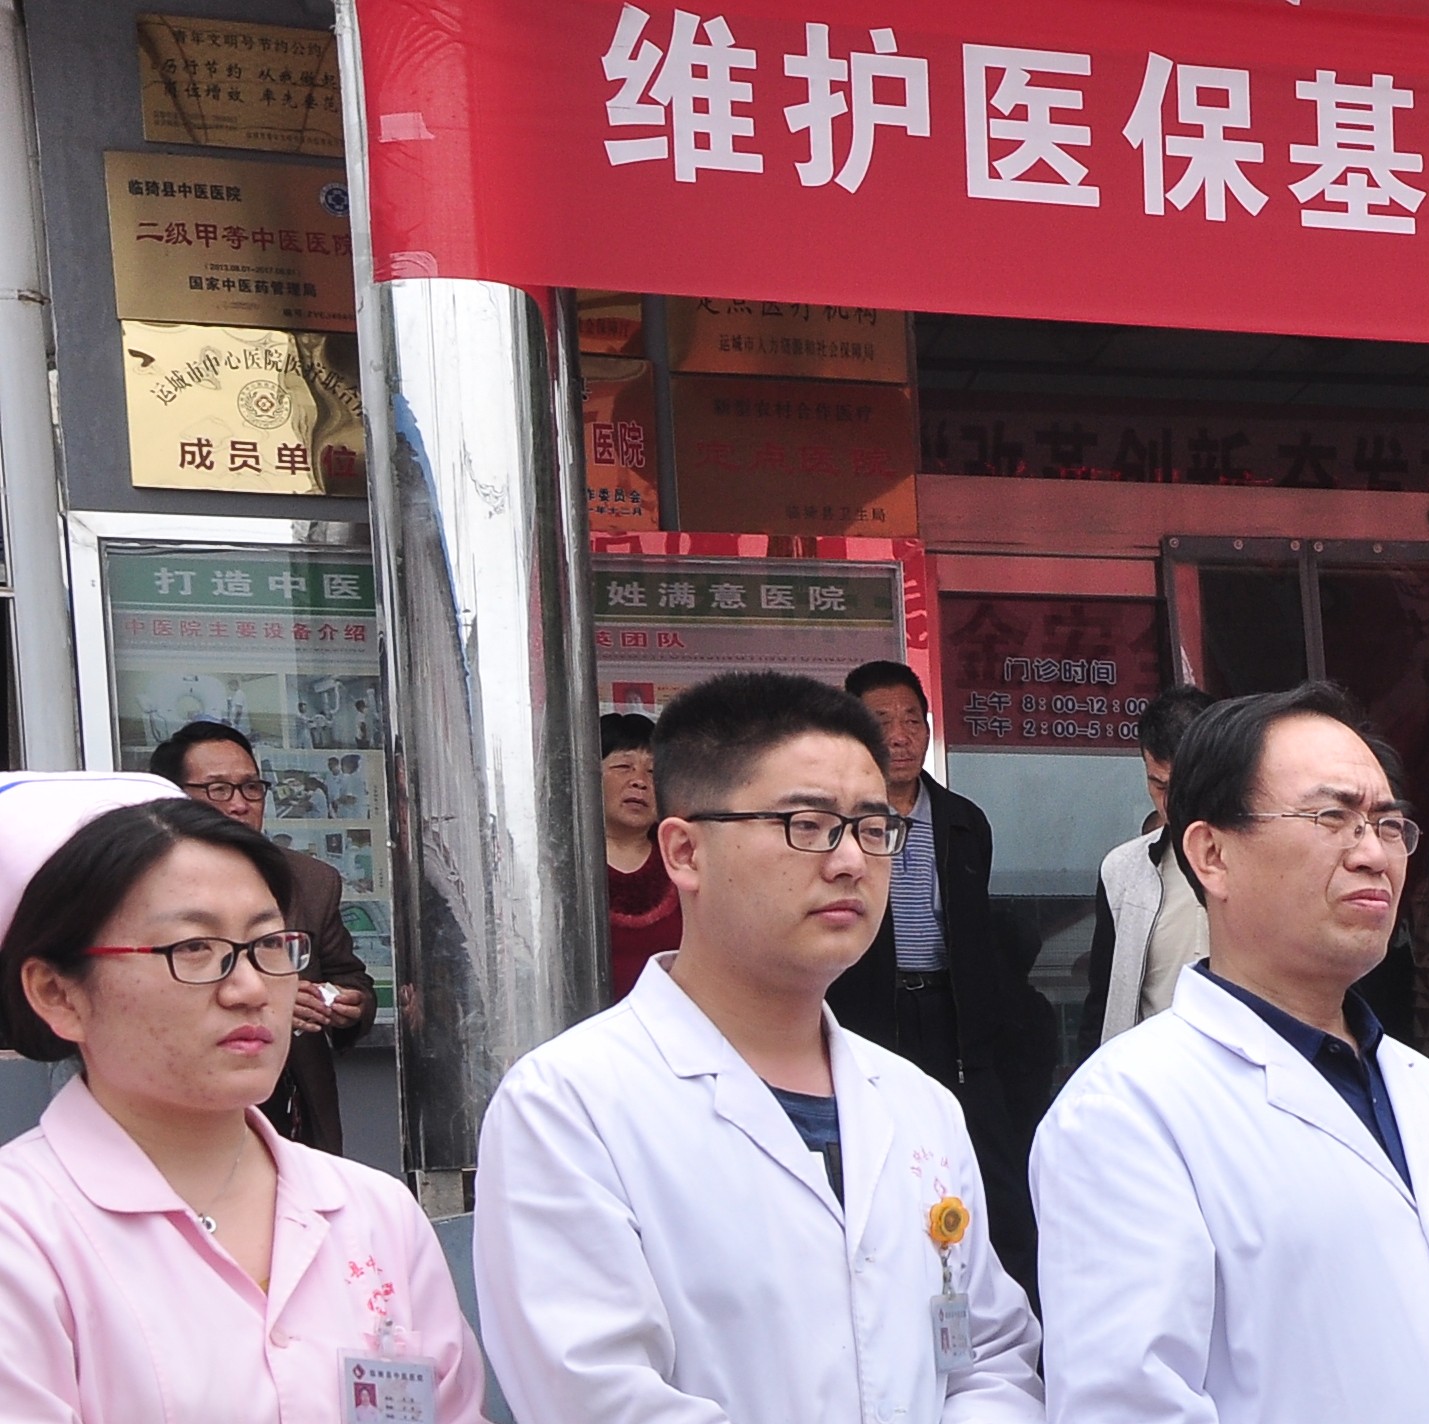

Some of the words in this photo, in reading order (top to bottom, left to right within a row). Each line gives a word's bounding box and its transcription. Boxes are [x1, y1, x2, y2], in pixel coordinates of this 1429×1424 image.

[128, 179, 242, 202] 临猗县中医医院
[136, 221, 353, 256] 二级甲等中医医院
[188, 275, 317, 297] 国家中医药管理局
[179, 437, 358, 477] 成员单位
[591, 420, 647, 468] 医院
[153, 566, 363, 601] 打造中医
[606, 580, 848, 612] 姓满意医院
[124, 618, 369, 643] 中医院主要设备介绍
[1003, 656, 1118, 686] 门诊时间
[963, 691, 1013, 714] 上午
[963, 716, 1013, 738] 下午
